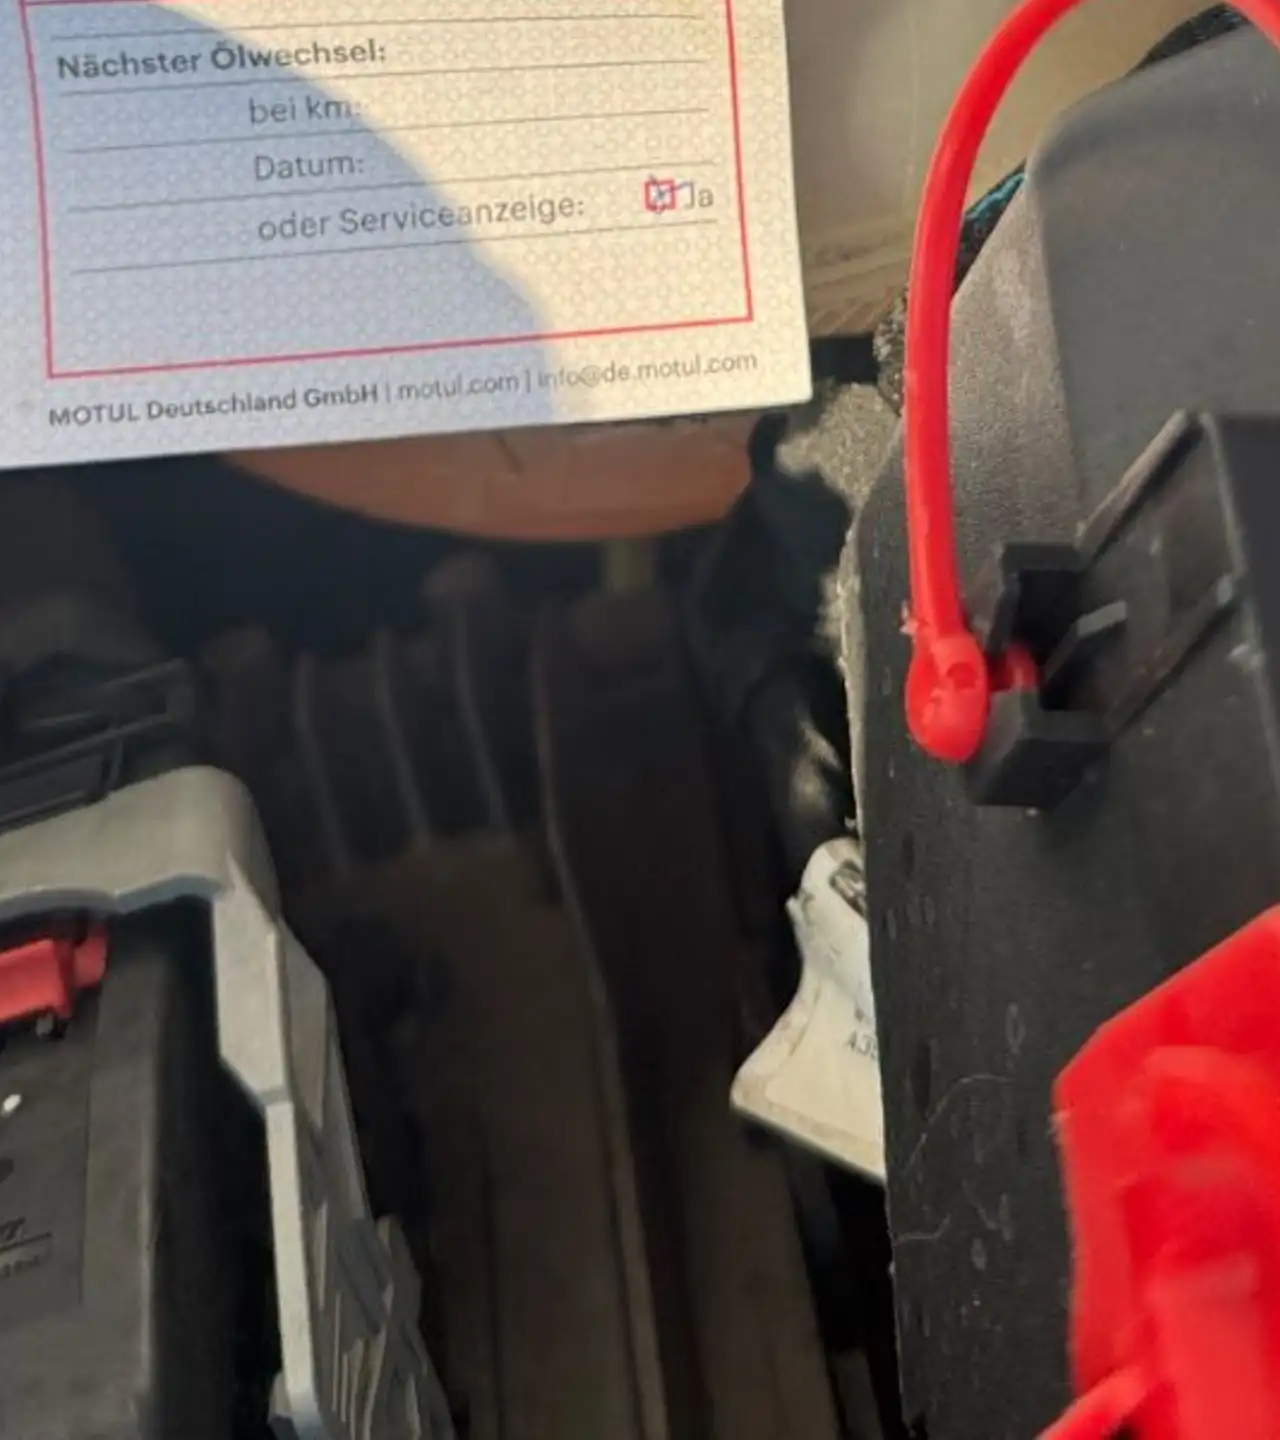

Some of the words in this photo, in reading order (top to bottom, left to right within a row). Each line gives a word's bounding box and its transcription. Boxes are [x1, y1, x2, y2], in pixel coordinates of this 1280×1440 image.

[57, 48, 202, 81] Nächster
[210, 37, 387, 72] Ölwechsel:
[248, 98, 297, 126] bei
[304, 95, 361, 122] km:
[254, 153, 364, 182] Datum:
[258, 213, 330, 241] oder
[339, 193, 586, 237] Serviceanzeige:
[683, 181, 714, 208] Ja
[48, 404, 141, 428] MOTUL
[147, 391, 297, 419] Deutschland
[303, 381, 379, 408] GmbH
[397, 372, 520, 400] motul.com
[537, 356, 758, 390] info@de.motul.com
